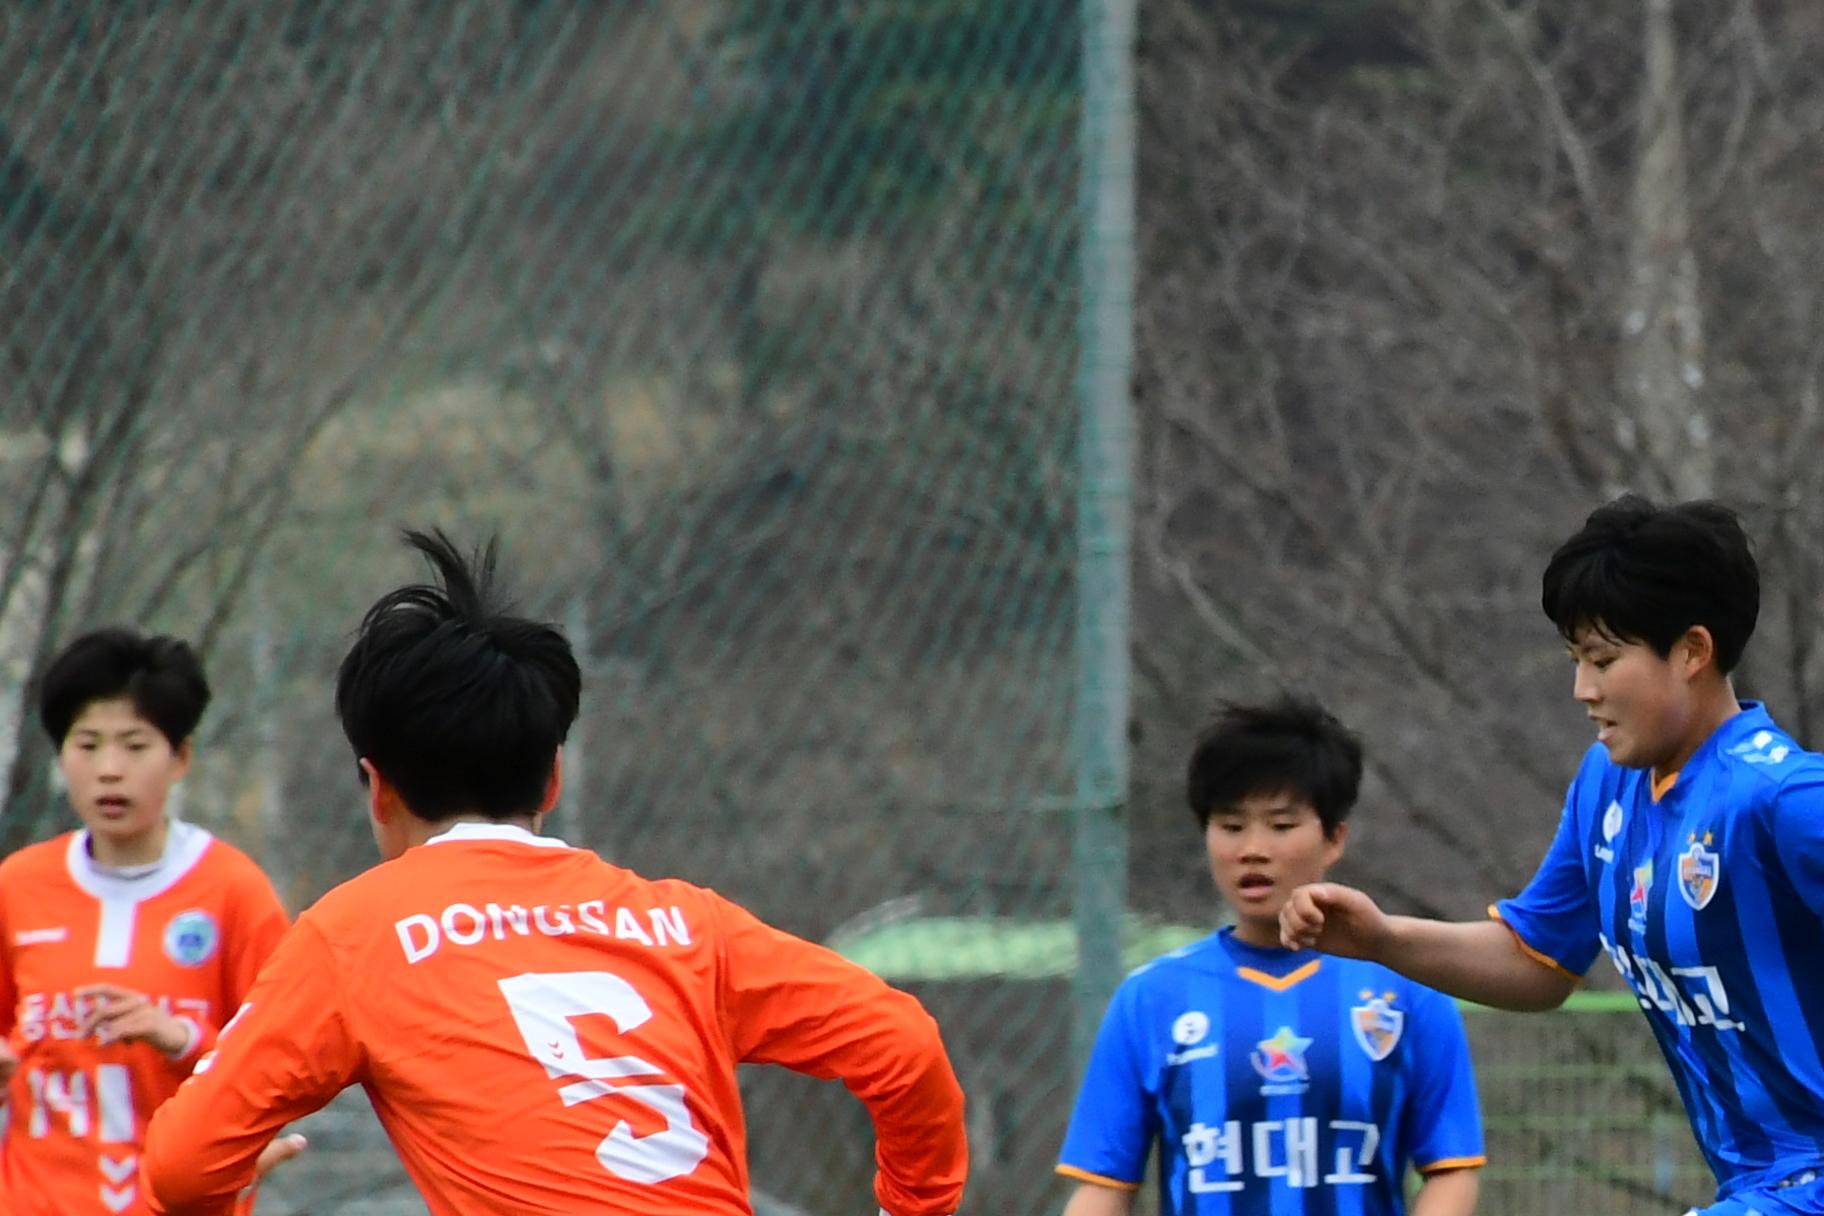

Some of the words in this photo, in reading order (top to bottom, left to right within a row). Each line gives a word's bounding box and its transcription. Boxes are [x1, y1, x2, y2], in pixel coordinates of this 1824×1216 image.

[395, 900, 691, 965] DONGSAN
[29, 1067, 90, 1139] 14
[497, 972, 708, 1185] 5
[1182, 1117, 1381, 1194] 현대고
